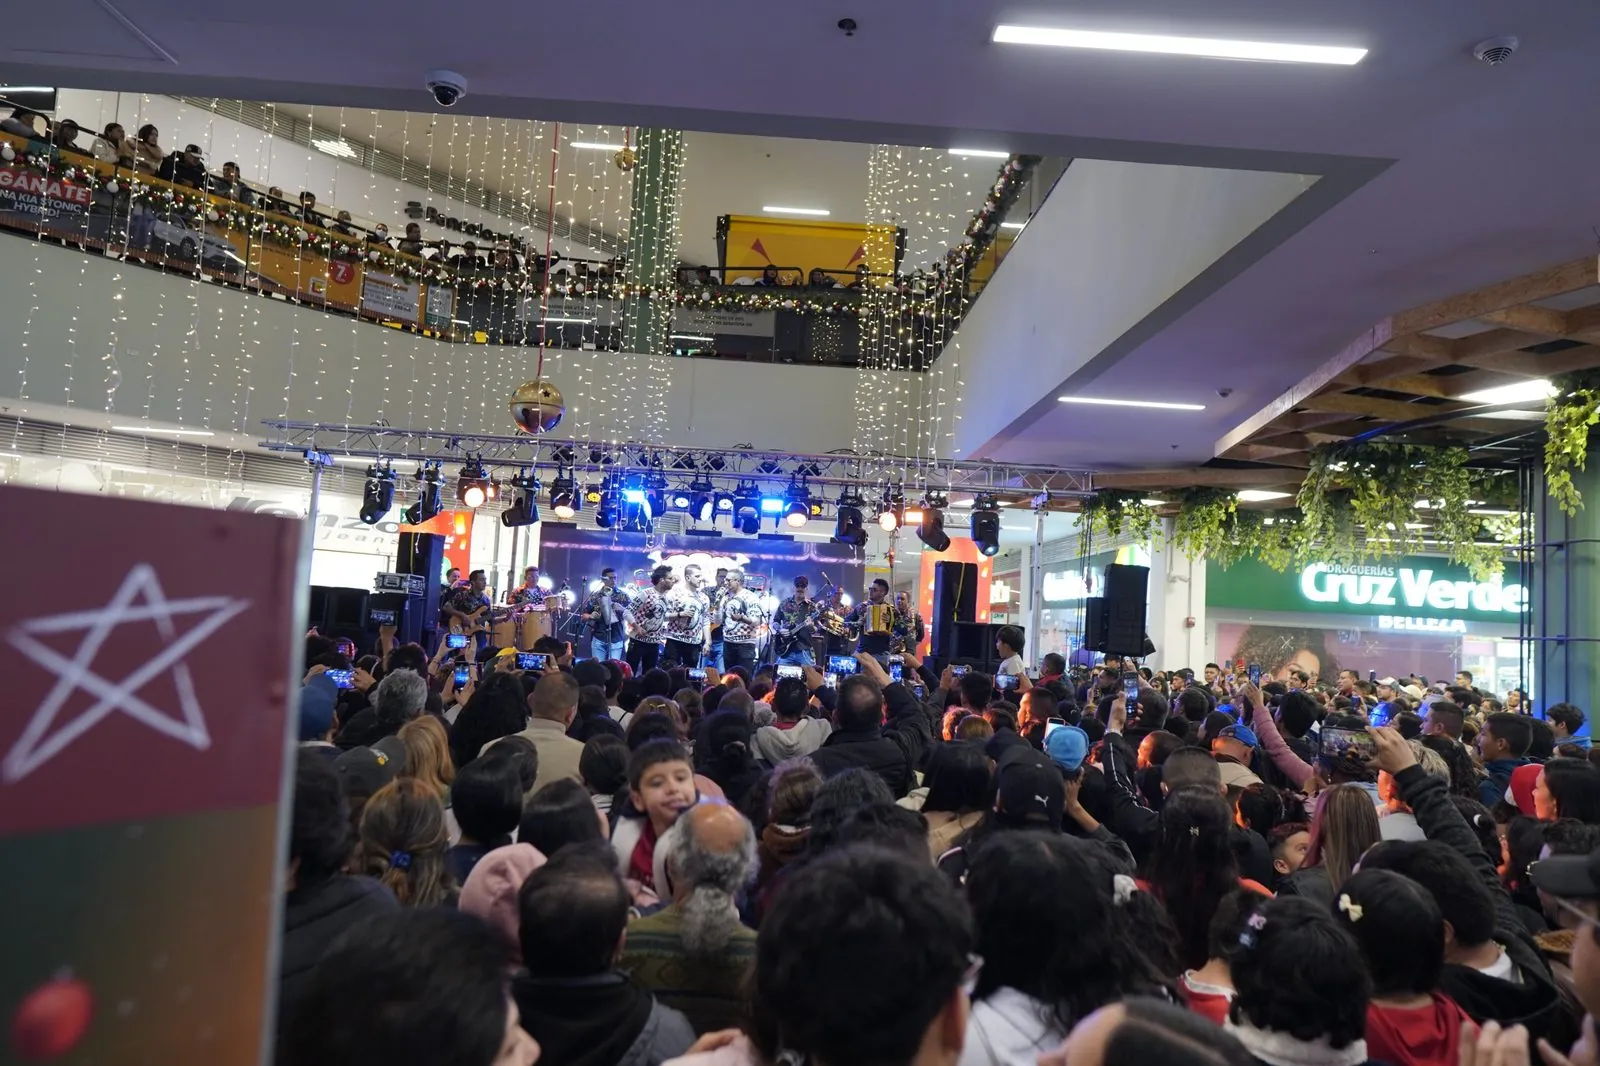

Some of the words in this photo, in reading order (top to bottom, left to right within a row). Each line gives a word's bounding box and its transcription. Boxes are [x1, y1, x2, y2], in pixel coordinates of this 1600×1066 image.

[0, 170, 88, 202] GÁNATE
[17, 193, 38, 205] KIA
[1326, 563, 1394, 577] DROGUERÍAS
[1301, 561, 1398, 606] Cruz
[1398, 567, 1529, 613] Verde
